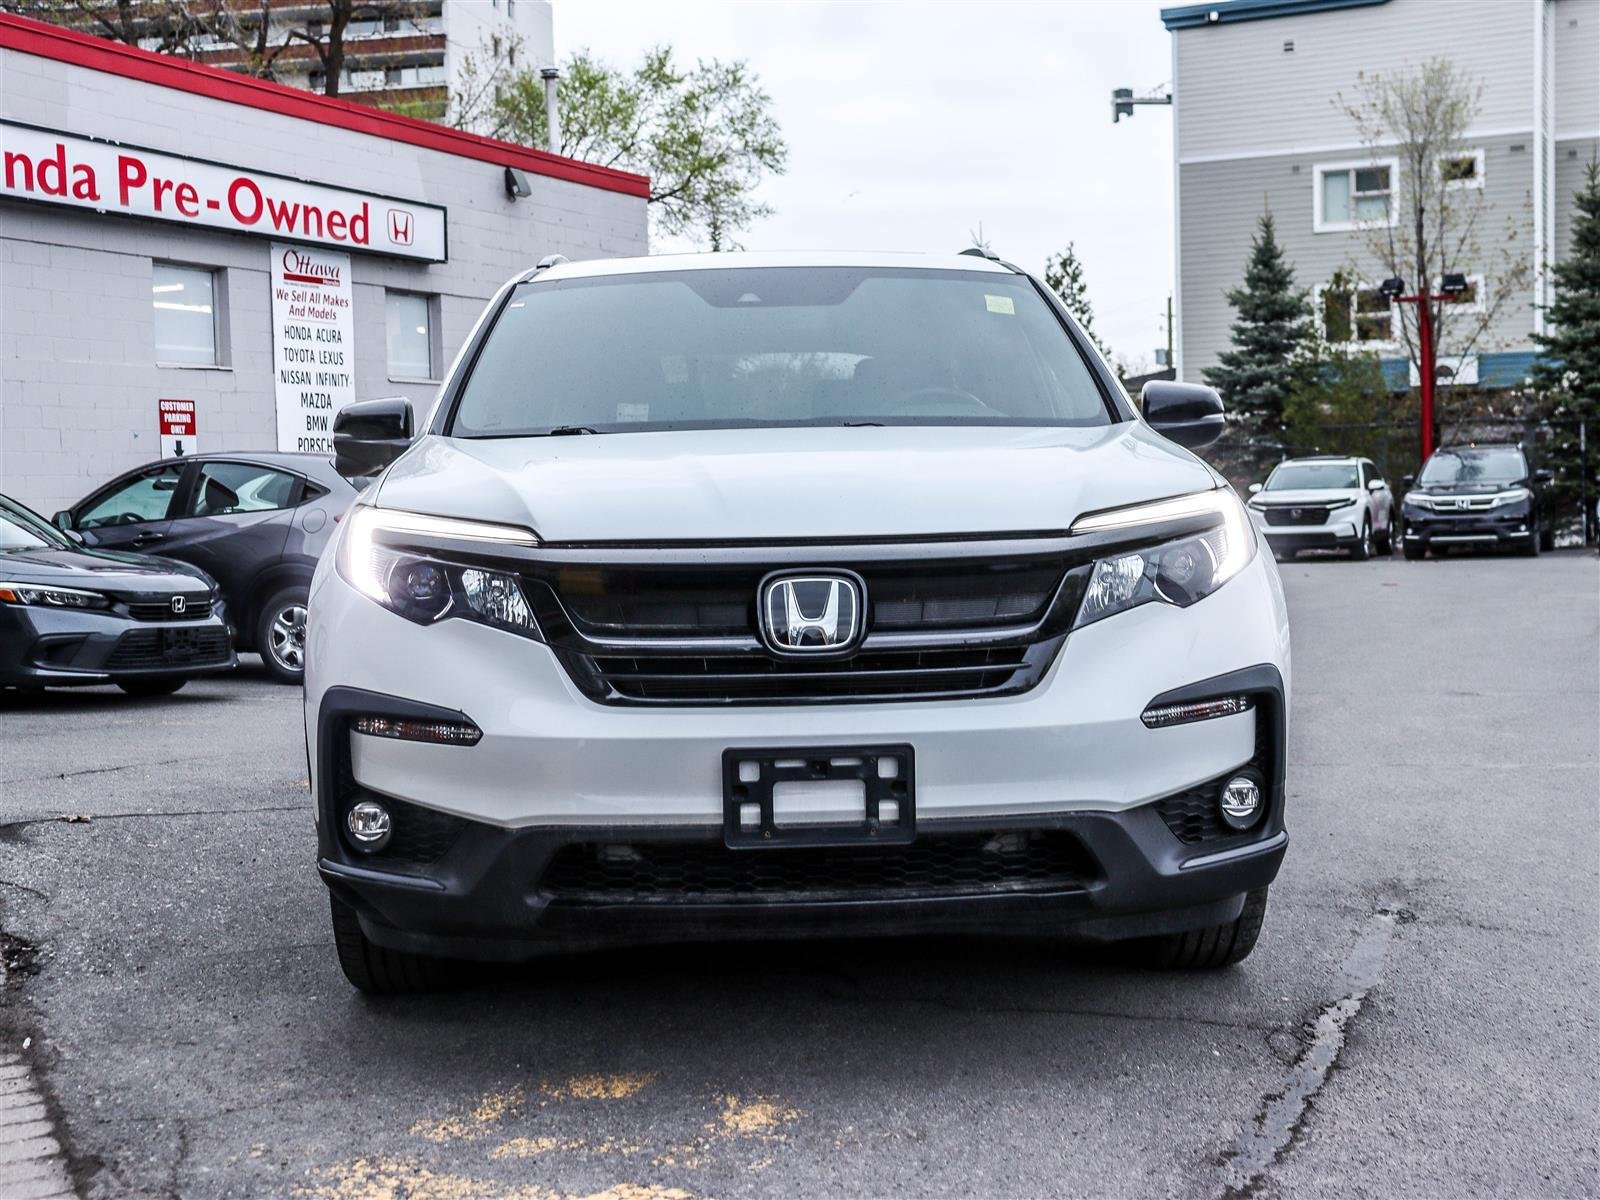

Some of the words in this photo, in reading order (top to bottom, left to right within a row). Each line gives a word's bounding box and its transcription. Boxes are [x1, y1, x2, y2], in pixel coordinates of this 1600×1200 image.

[117, 154, 370, 246] Pre-Owned
[283, 248, 340, 278] Ottawa
[276, 287, 289, 301] We
[291, 290, 307, 303] Sell
[308, 292, 320, 305] All
[322, 294, 349, 308] Makes
[288, 304, 306, 318] And
[307, 306, 337, 321] Models
[284, 325, 312, 341] HONDA
[316, 328, 343, 344] ACURA
[284, 347, 315, 363] TOYOTA
[319, 350, 344, 366] LEXUS
[280, 369, 312, 385] NISSAN
[315, 372, 350, 387] INFINITY
[160, 401, 194, 412] CUSTOMER
[300, 391, 333, 409] MAZDA
[306, 415, 328, 431] BMW
[298, 437, 335, 453] PORSCH
